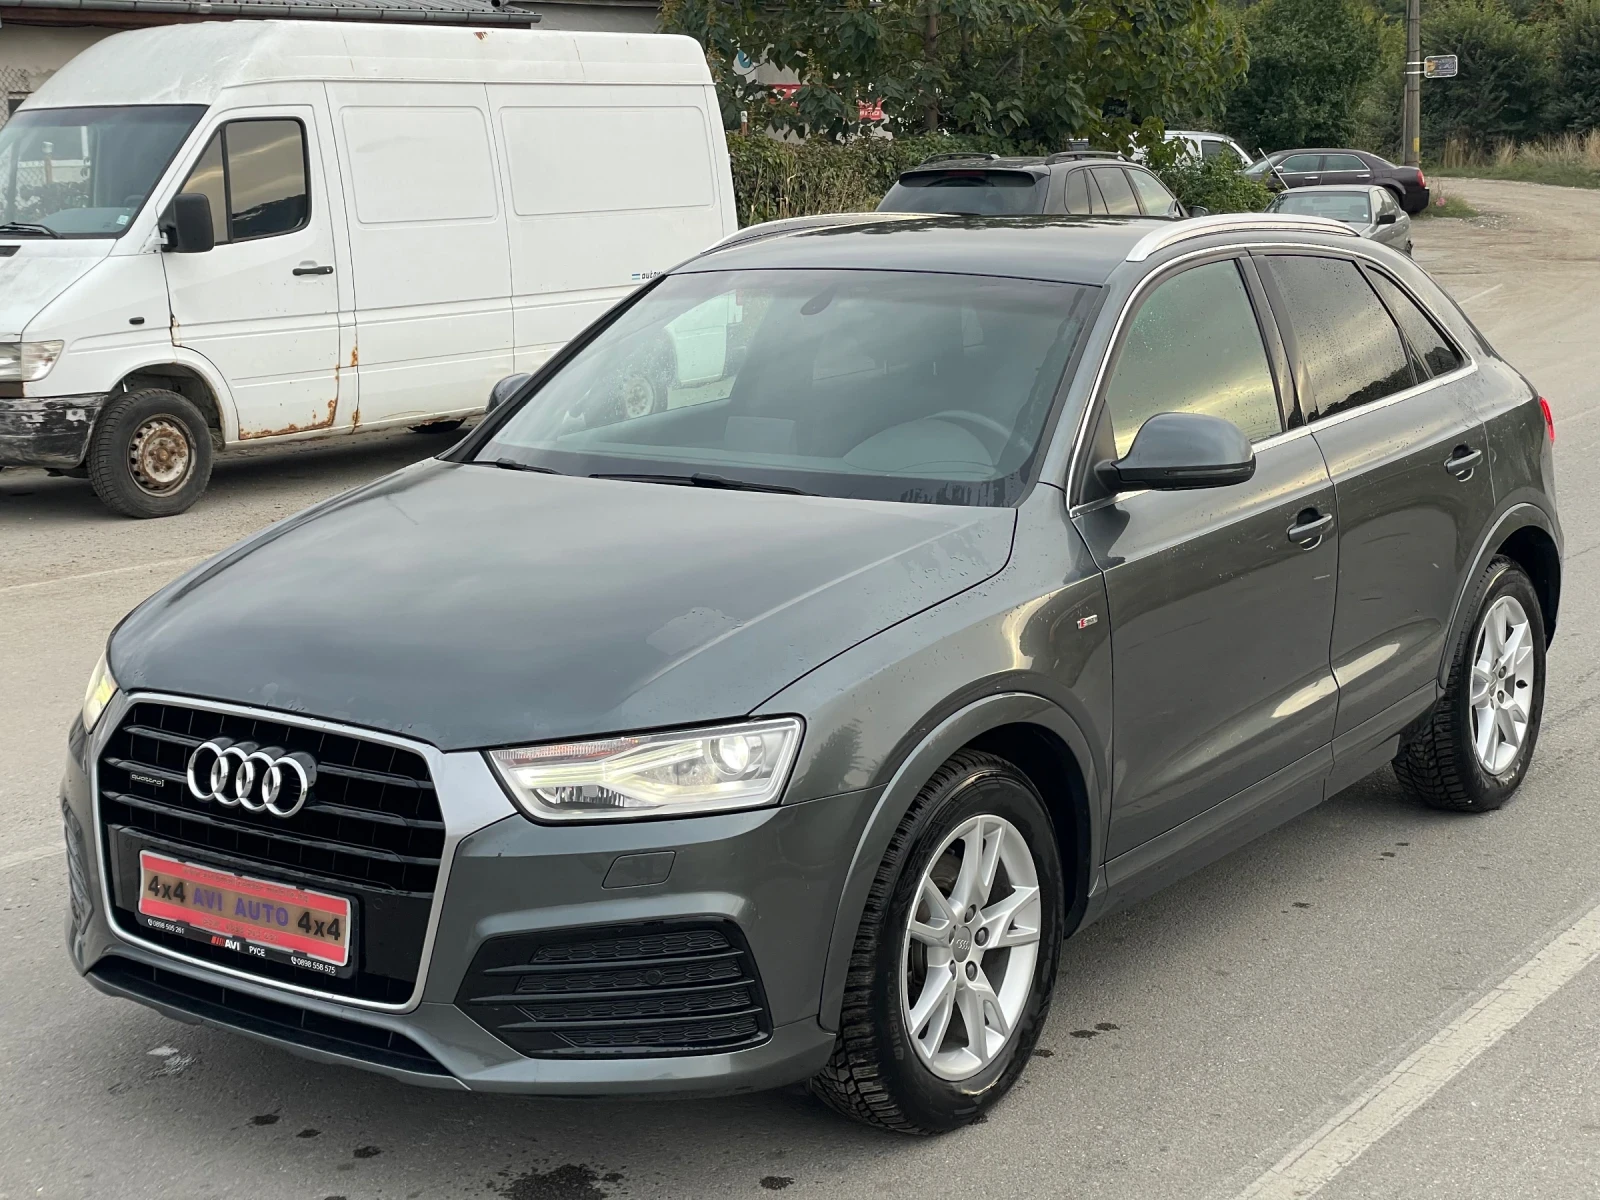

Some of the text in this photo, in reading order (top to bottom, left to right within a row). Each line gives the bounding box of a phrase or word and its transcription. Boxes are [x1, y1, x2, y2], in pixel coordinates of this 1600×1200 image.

[131, 774, 162, 785] quattro
[147, 875, 186, 903] 4x4
[193, 887, 223, 912] AVI
[234, 897, 289, 927] AUTO
[297, 911, 341, 941] 4x4
[224, 939, 240, 951] AVI
[296, 958, 336, 974] 0898 558 575
